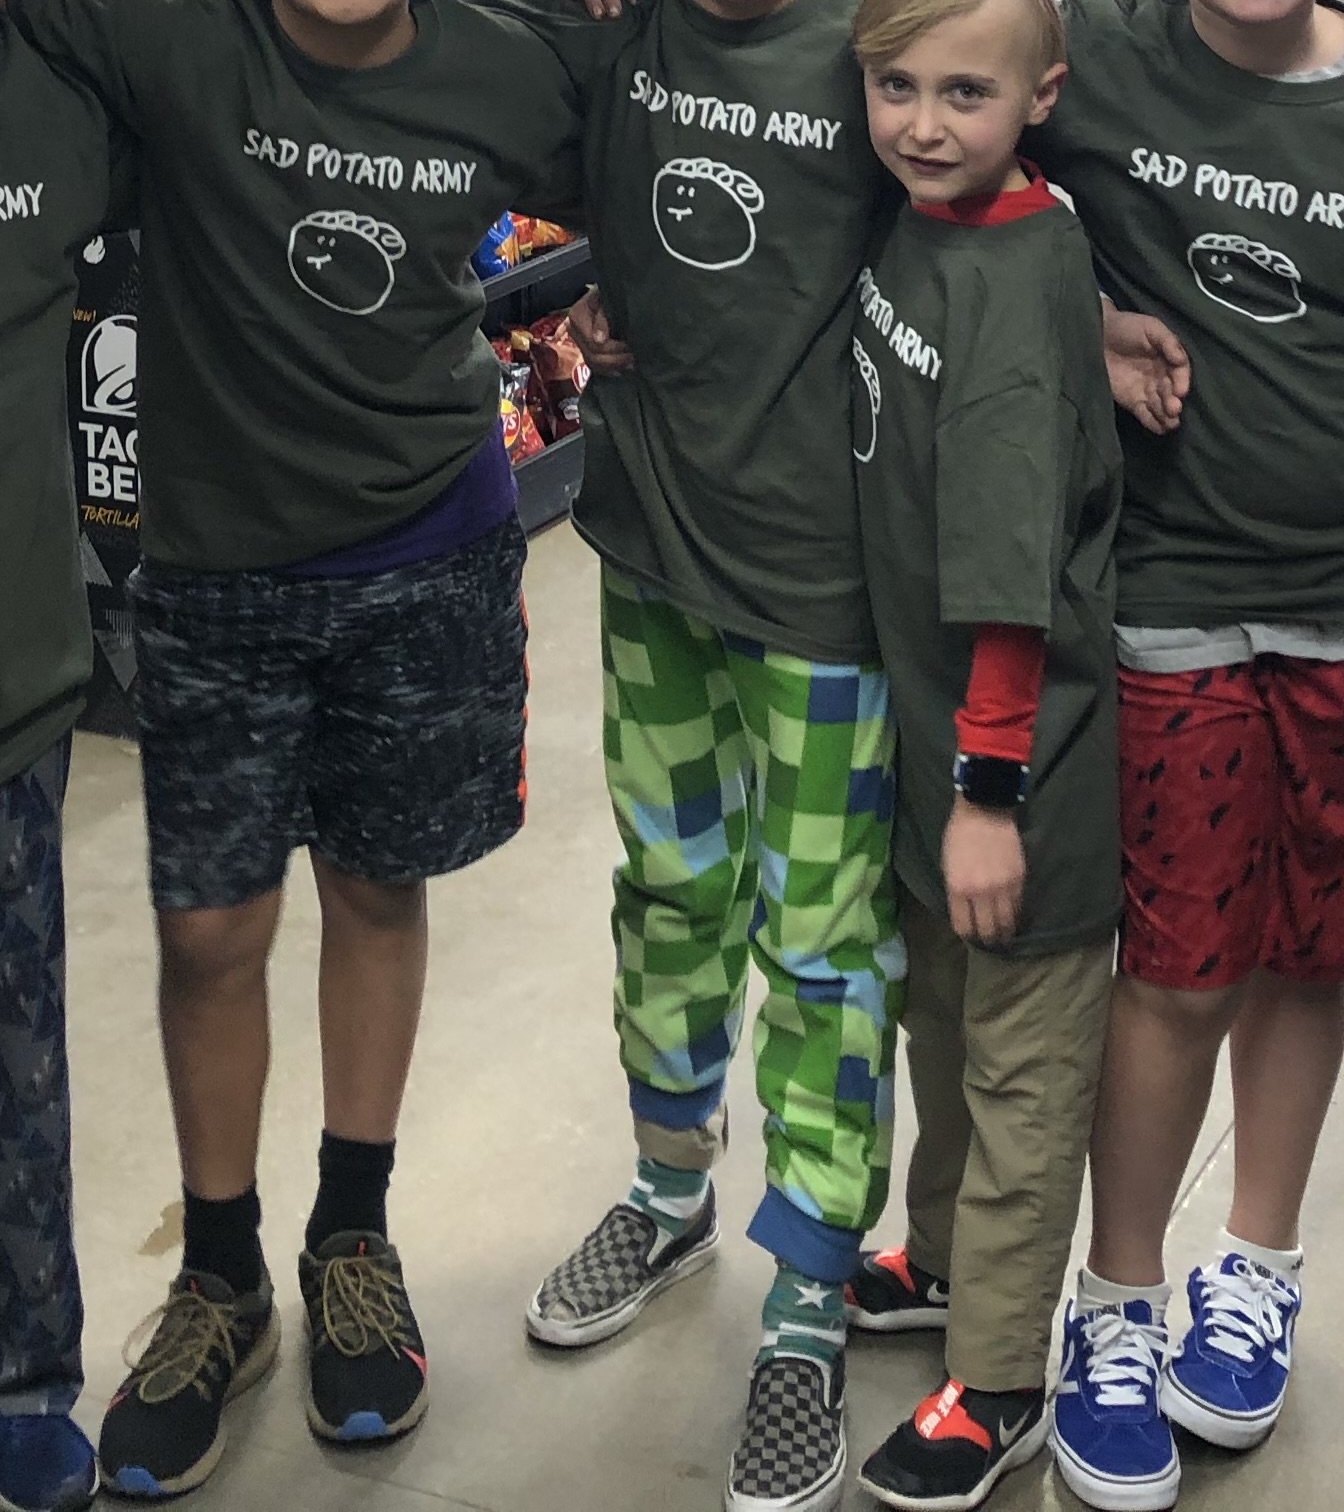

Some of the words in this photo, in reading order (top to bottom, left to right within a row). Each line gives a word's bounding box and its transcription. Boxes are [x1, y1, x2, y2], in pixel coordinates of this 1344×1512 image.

[630, 70, 668, 113] SAD
[672, 90, 757, 137] POTATO
[764, 109, 842, 151] ARMY
[243, 129, 300, 168] SAD
[306, 144, 405, 190] POTATO
[412, 157, 476, 193] ARMY
[1128, 148, 1188, 188] SAD
[1195, 163, 1298, 216] POTATO
[888, 320, 942, 380] ARMY
[88, 462, 136, 502] BE
